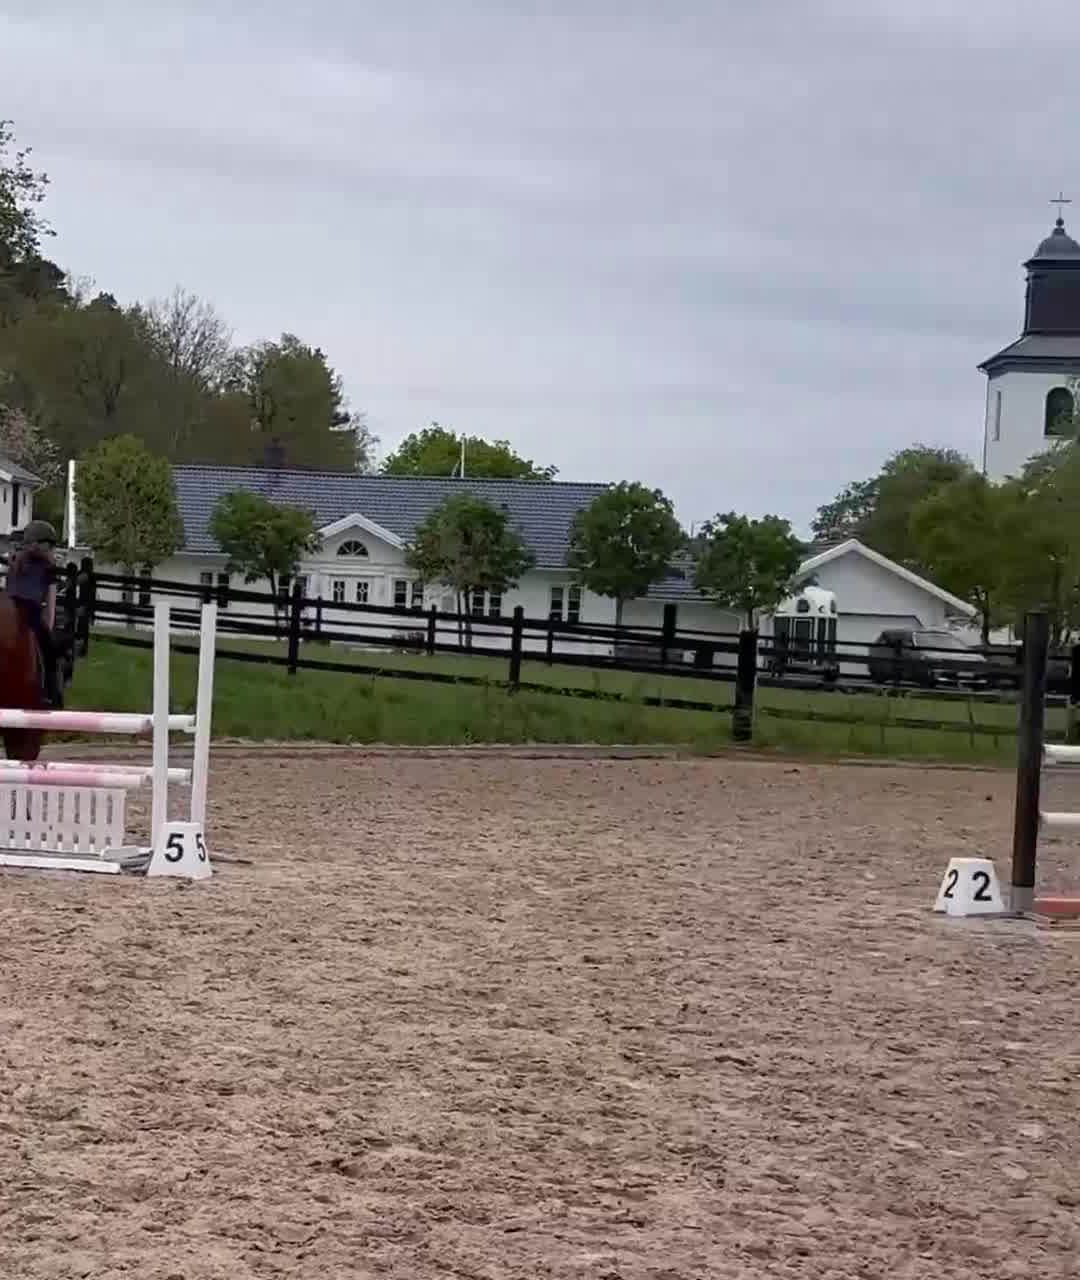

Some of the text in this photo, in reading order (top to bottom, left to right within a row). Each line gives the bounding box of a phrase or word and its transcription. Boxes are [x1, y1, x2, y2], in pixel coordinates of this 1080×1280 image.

[164, 833, 184, 862] 5
[195, 833, 206, 862] 5
[943, 869, 959, 899] 2
[972, 871, 992, 901] 2
